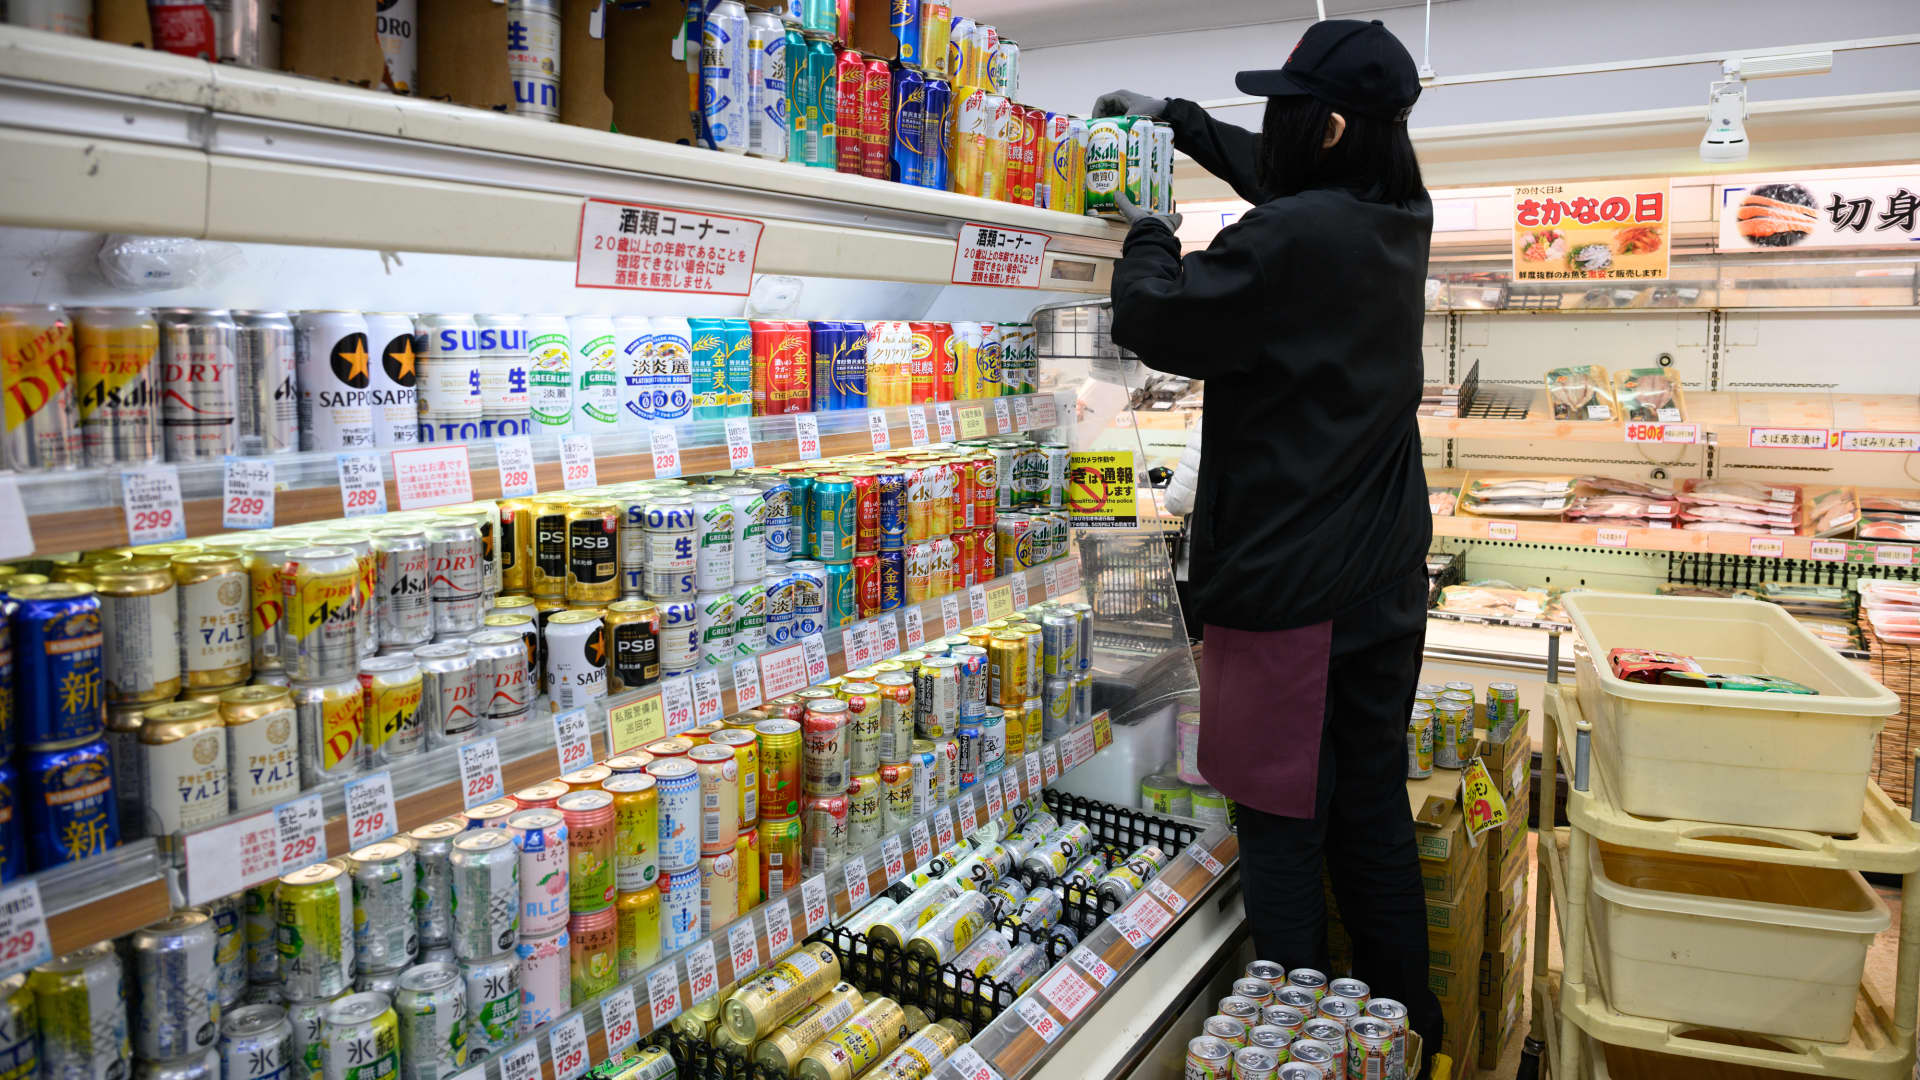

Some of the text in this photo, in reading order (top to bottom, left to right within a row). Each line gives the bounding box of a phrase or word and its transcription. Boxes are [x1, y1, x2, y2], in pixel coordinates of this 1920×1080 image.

[1088, 142, 1118, 162] Asahi
[1517, 192, 1664, 226] さかなの日
[1826, 188, 1919, 232] 切身
[619, 208, 730, 240] 酒類コーナー
[976, 228, 1032, 250] 酒類コーナー
[594, 235, 746, 263] 20歳以上の年齢であることを
[616, 254, 726, 276] 確認できない場合には
[972, 260, 1028, 274] 確認できない場合には
[615, 270, 713, 290] 酒類を販売しません
[970, 272, 1021, 284] 酒類を販売しません
[176, 353, 216, 362] SUPER
[712, 348, 726, 390] 金麦
[793, 348, 808, 386] 金麦
[508, 366, 526, 394] 生
[543, 388, 566, 399] 淡麗
[874, 432, 886, 444] 239
[912, 429, 925, 440] 239
[940, 425, 952, 436] 239
[1760, 433, 1821, 444] さば西京漬け
[732, 446, 749, 460] 239
[801, 440, 816, 452] 239
[342, 465, 376, 474] 黒ラベル
[401, 460, 462, 474] これはお酒です
[656, 455, 675, 470] 239
[504, 472, 528, 487] 289
[568, 465, 589, 480] 239
[347, 489, 377, 508] 289
[1106, 486, 1132, 496] します
[228, 496, 264, 515] 289
[132, 510, 174, 532] 299
[572, 536, 609, 549] PSB
[674, 536, 692, 560] 生
[884, 567, 898, 602] 金麦
[1015, 594, 1026, 604] 189
[974, 608, 984, 620] 189
[945, 617, 957, 629] 189
[908, 630, 921, 643] 189
[618, 639, 656, 653] PSB
[855, 648, 869, 660] 189
[882, 640, 896, 651] 189
[809, 661, 824, 676] 189
[60, 668, 100, 715] 新
[738, 686, 756, 702] 189
[615, 700, 658, 721] 私服警備員
[699, 698, 717, 716] 219
[669, 708, 688, 726] 219
[559, 720, 584, 734] 黒ラベル
[626, 718, 652, 735] 巡回中
[564, 744, 586, 764] 229
[468, 774, 494, 796] 229
[1029, 776, 1039, 790] 199
[1006, 788, 1018, 804] 199
[989, 800, 1000, 816] 119
[353, 812, 384, 838] 219
[962, 816, 974, 832] 139
[62, 814, 110, 862] 新
[938, 830, 951, 846] 149
[282, 836, 316, 864] 229
[916, 844, 928, 860] 149
[887, 860, 901, 878] 149
[850, 882, 865, 900] 149
[808, 906, 824, 924] 139
[576, 929, 615, 945] ほろよい
[770, 928, 788, 948] 139
[1127, 930, 1142, 944] 179
[734, 948, 753, 970] 139
[1094, 964, 1108, 980] 259
[484, 976, 506, 1000] 氷
[692, 974, 712, 996] 139
[654, 994, 675, 1018] 139
[608, 1020, 632, 1044] 139
[1037, 1018, 1053, 1036] 169
[250, 1048, 274, 1075] 氷
[556, 1050, 582, 1076] 139
